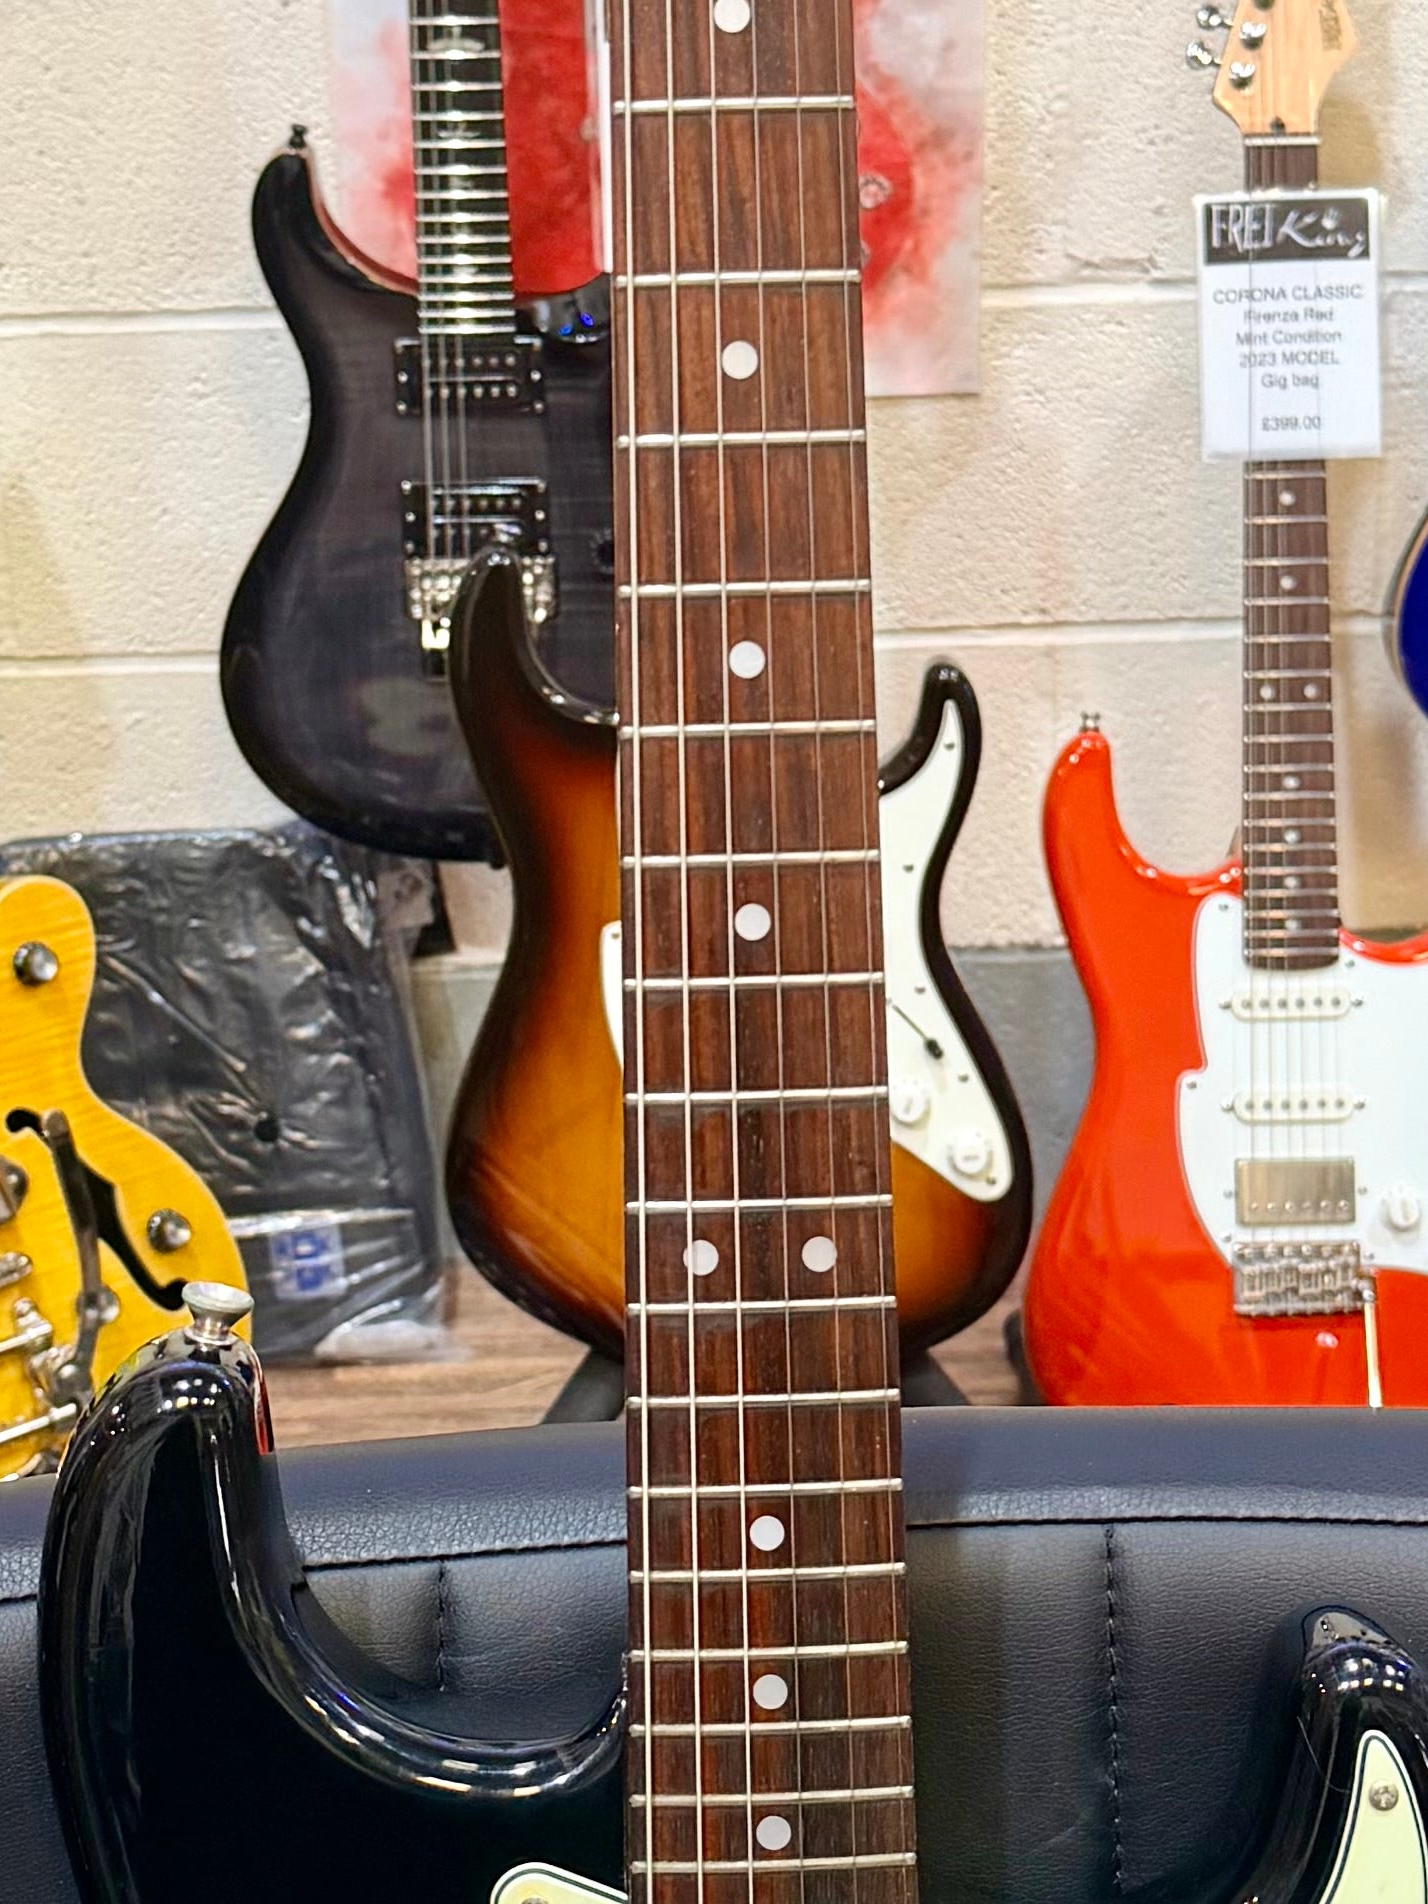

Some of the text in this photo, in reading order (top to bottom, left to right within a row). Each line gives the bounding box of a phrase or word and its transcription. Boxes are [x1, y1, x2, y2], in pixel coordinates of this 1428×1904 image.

[1213, 283, 1363, 305] CORONA CLASSIC
[1304, 305, 1335, 322] Red
[1236, 328, 1343, 347] Mint Condition
[1281, 350, 1340, 366] MODEL
[1260, 372, 1320, 391] Gig bag
